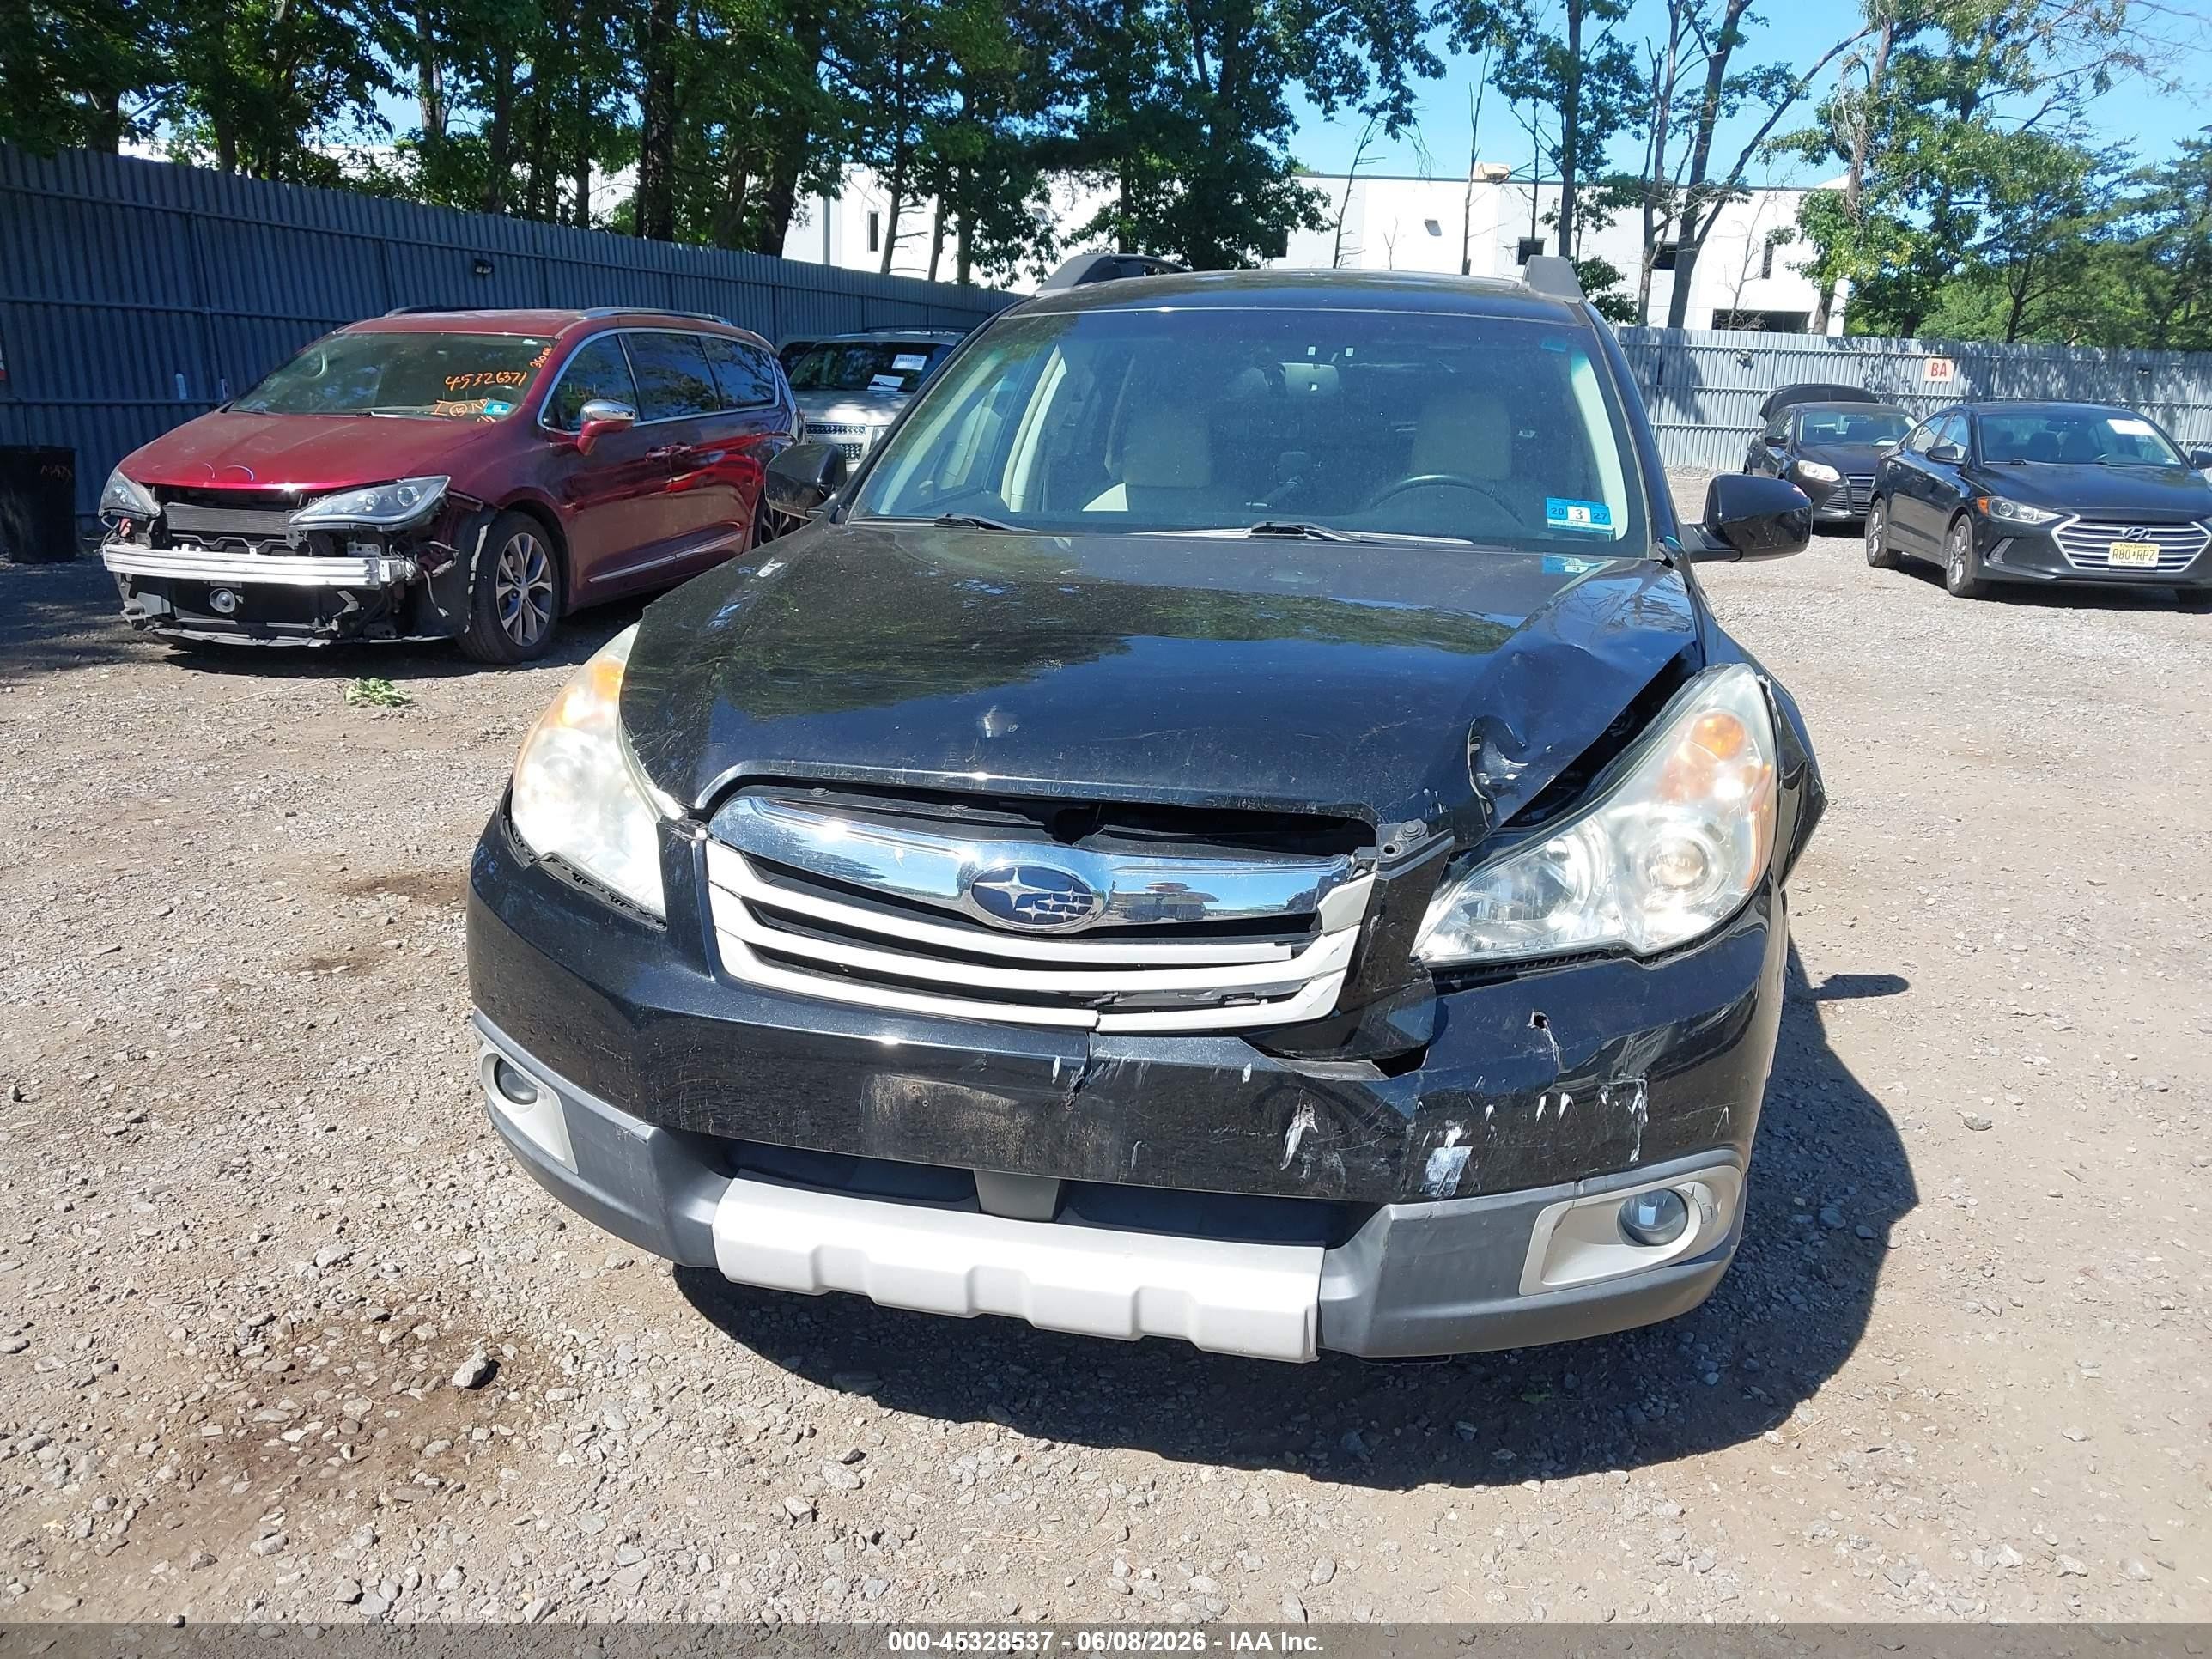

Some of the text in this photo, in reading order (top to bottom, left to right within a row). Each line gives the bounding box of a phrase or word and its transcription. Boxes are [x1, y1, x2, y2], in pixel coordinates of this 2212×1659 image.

[1930, 362, 1947, 377] BA
[445, 371, 527, 392] 45326371
[1551, 507, 1608, 520] 20 3 27
